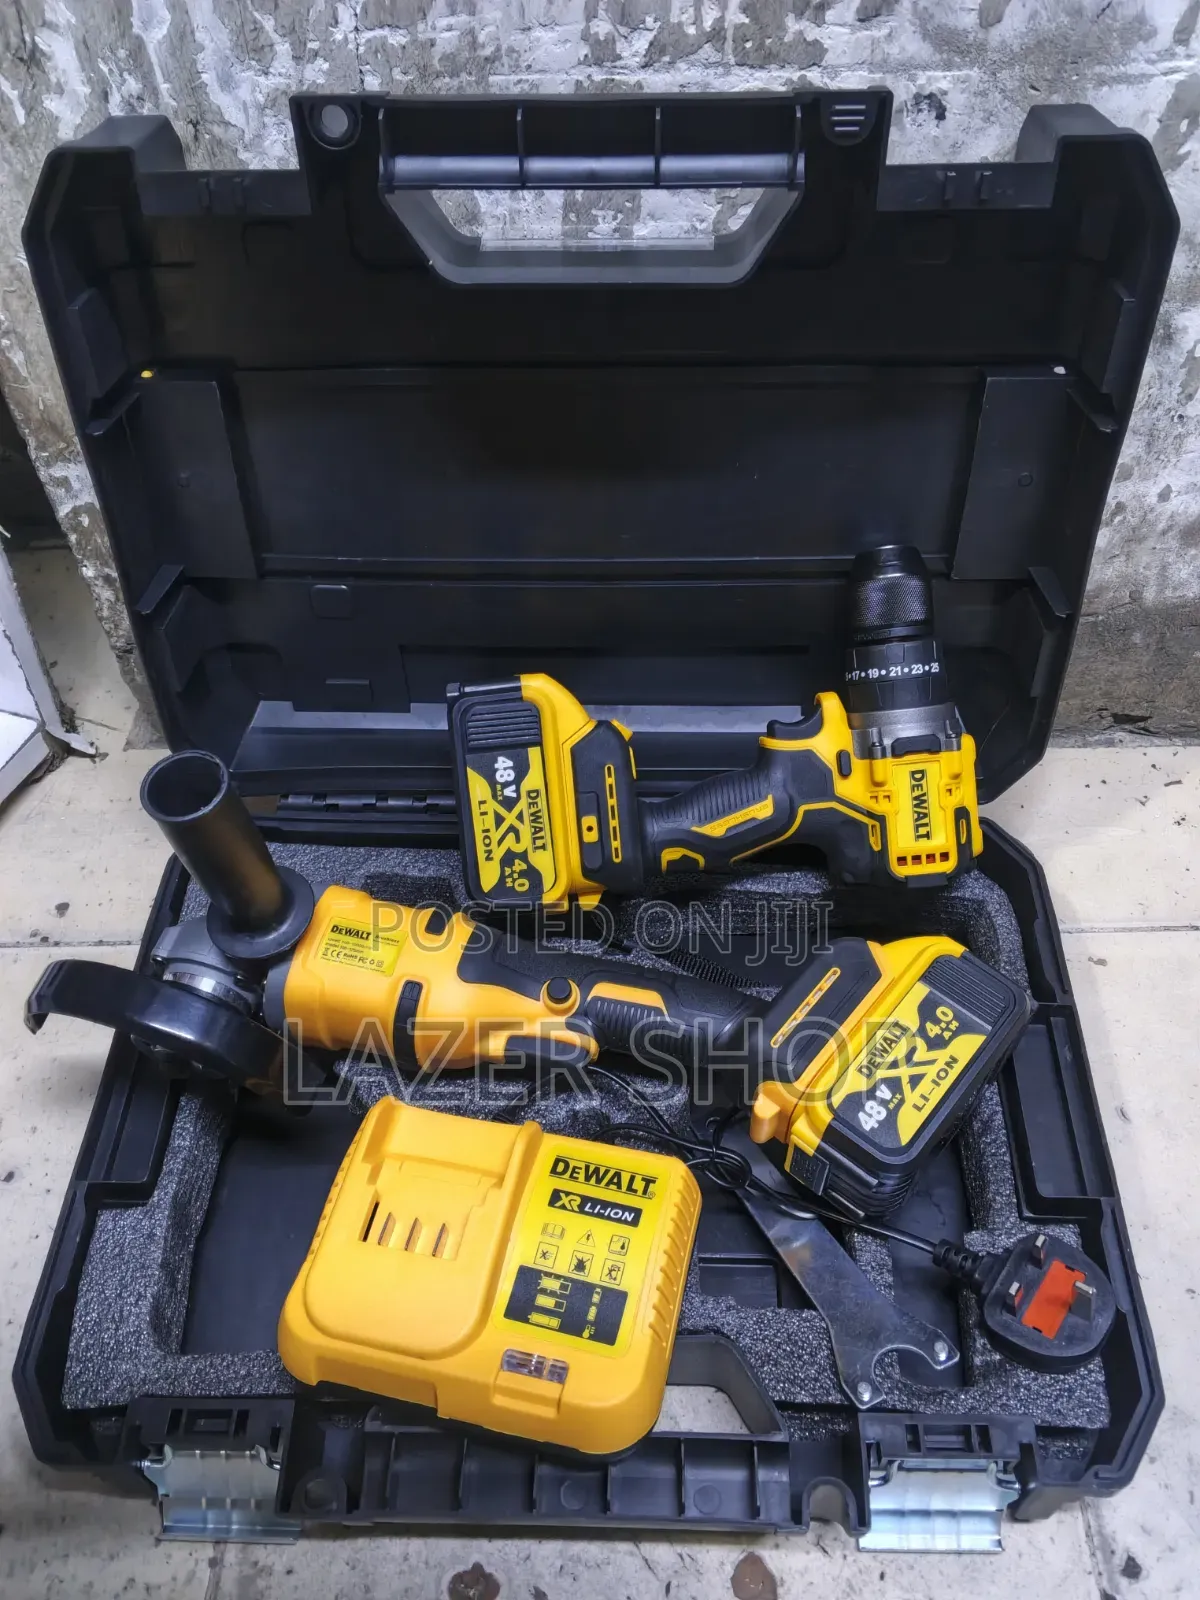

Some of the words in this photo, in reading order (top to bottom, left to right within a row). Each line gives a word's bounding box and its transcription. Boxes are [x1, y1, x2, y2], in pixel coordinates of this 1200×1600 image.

[852, 670, 860, 680] 17
[868, 668, 879, 678] 19
[889, 666, 902, 676] 21
[911, 664, 923, 674] 23
[930, 662, 940, 672] 25
[478, 800, 494, 862] LI-ION
[512, 858, 530, 892] 4.0
[926, 1006, 954, 1038] 4.0
[912, 1054, 960, 1112] LI-ION
[888, 1093, 902, 1110] MAX
[554, 1192, 582, 1212] XR
[584, 1202, 635, 1222] LI-ION
